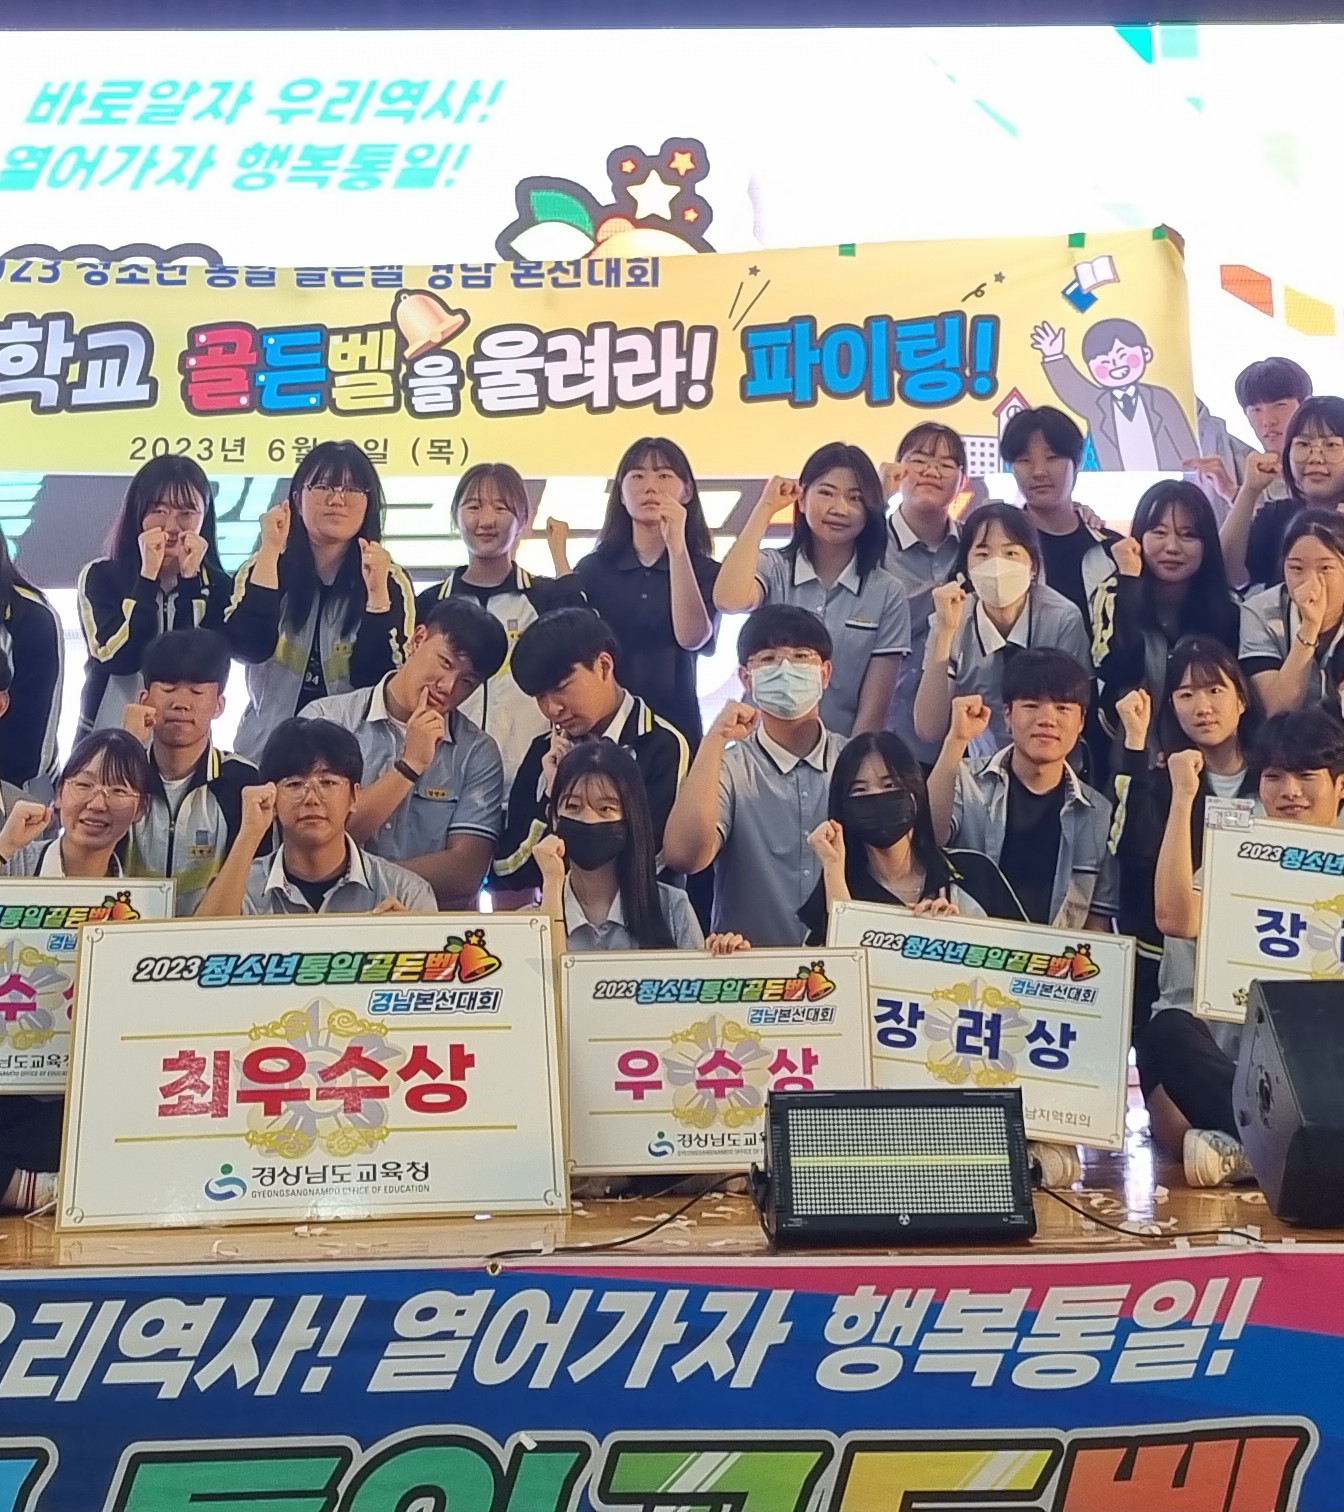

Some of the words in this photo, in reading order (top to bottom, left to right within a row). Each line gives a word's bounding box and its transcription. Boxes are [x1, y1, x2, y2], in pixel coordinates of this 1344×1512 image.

[25, 78, 255, 125] 바로알자
[265, 78, 506, 125] 우리역사!
[233, 142, 471, 190] 행복통일!
[468, 323, 714, 417] 울려라!
[739, 310, 1000, 408] 파이팅!
[130, 437, 246, 462] 2023년
[411, 437, 470, 467] (목)
[367, 988, 503, 1016] 경남본선대회
[1009, 977, 1099, 1004] 경남본선대회
[747, 1006, 836, 1026] 경남본선대회
[158, 1043, 476, 1119] 최우수상
[251, 1161, 430, 1187] 경상남도교육청
[371, 1185, 382, 1194] OF
[383, 1184, 430, 1194] EDUCATION
[366, 1287, 801, 1394] 열어가자
[814, 1277, 1262, 1393] 행복통일!
